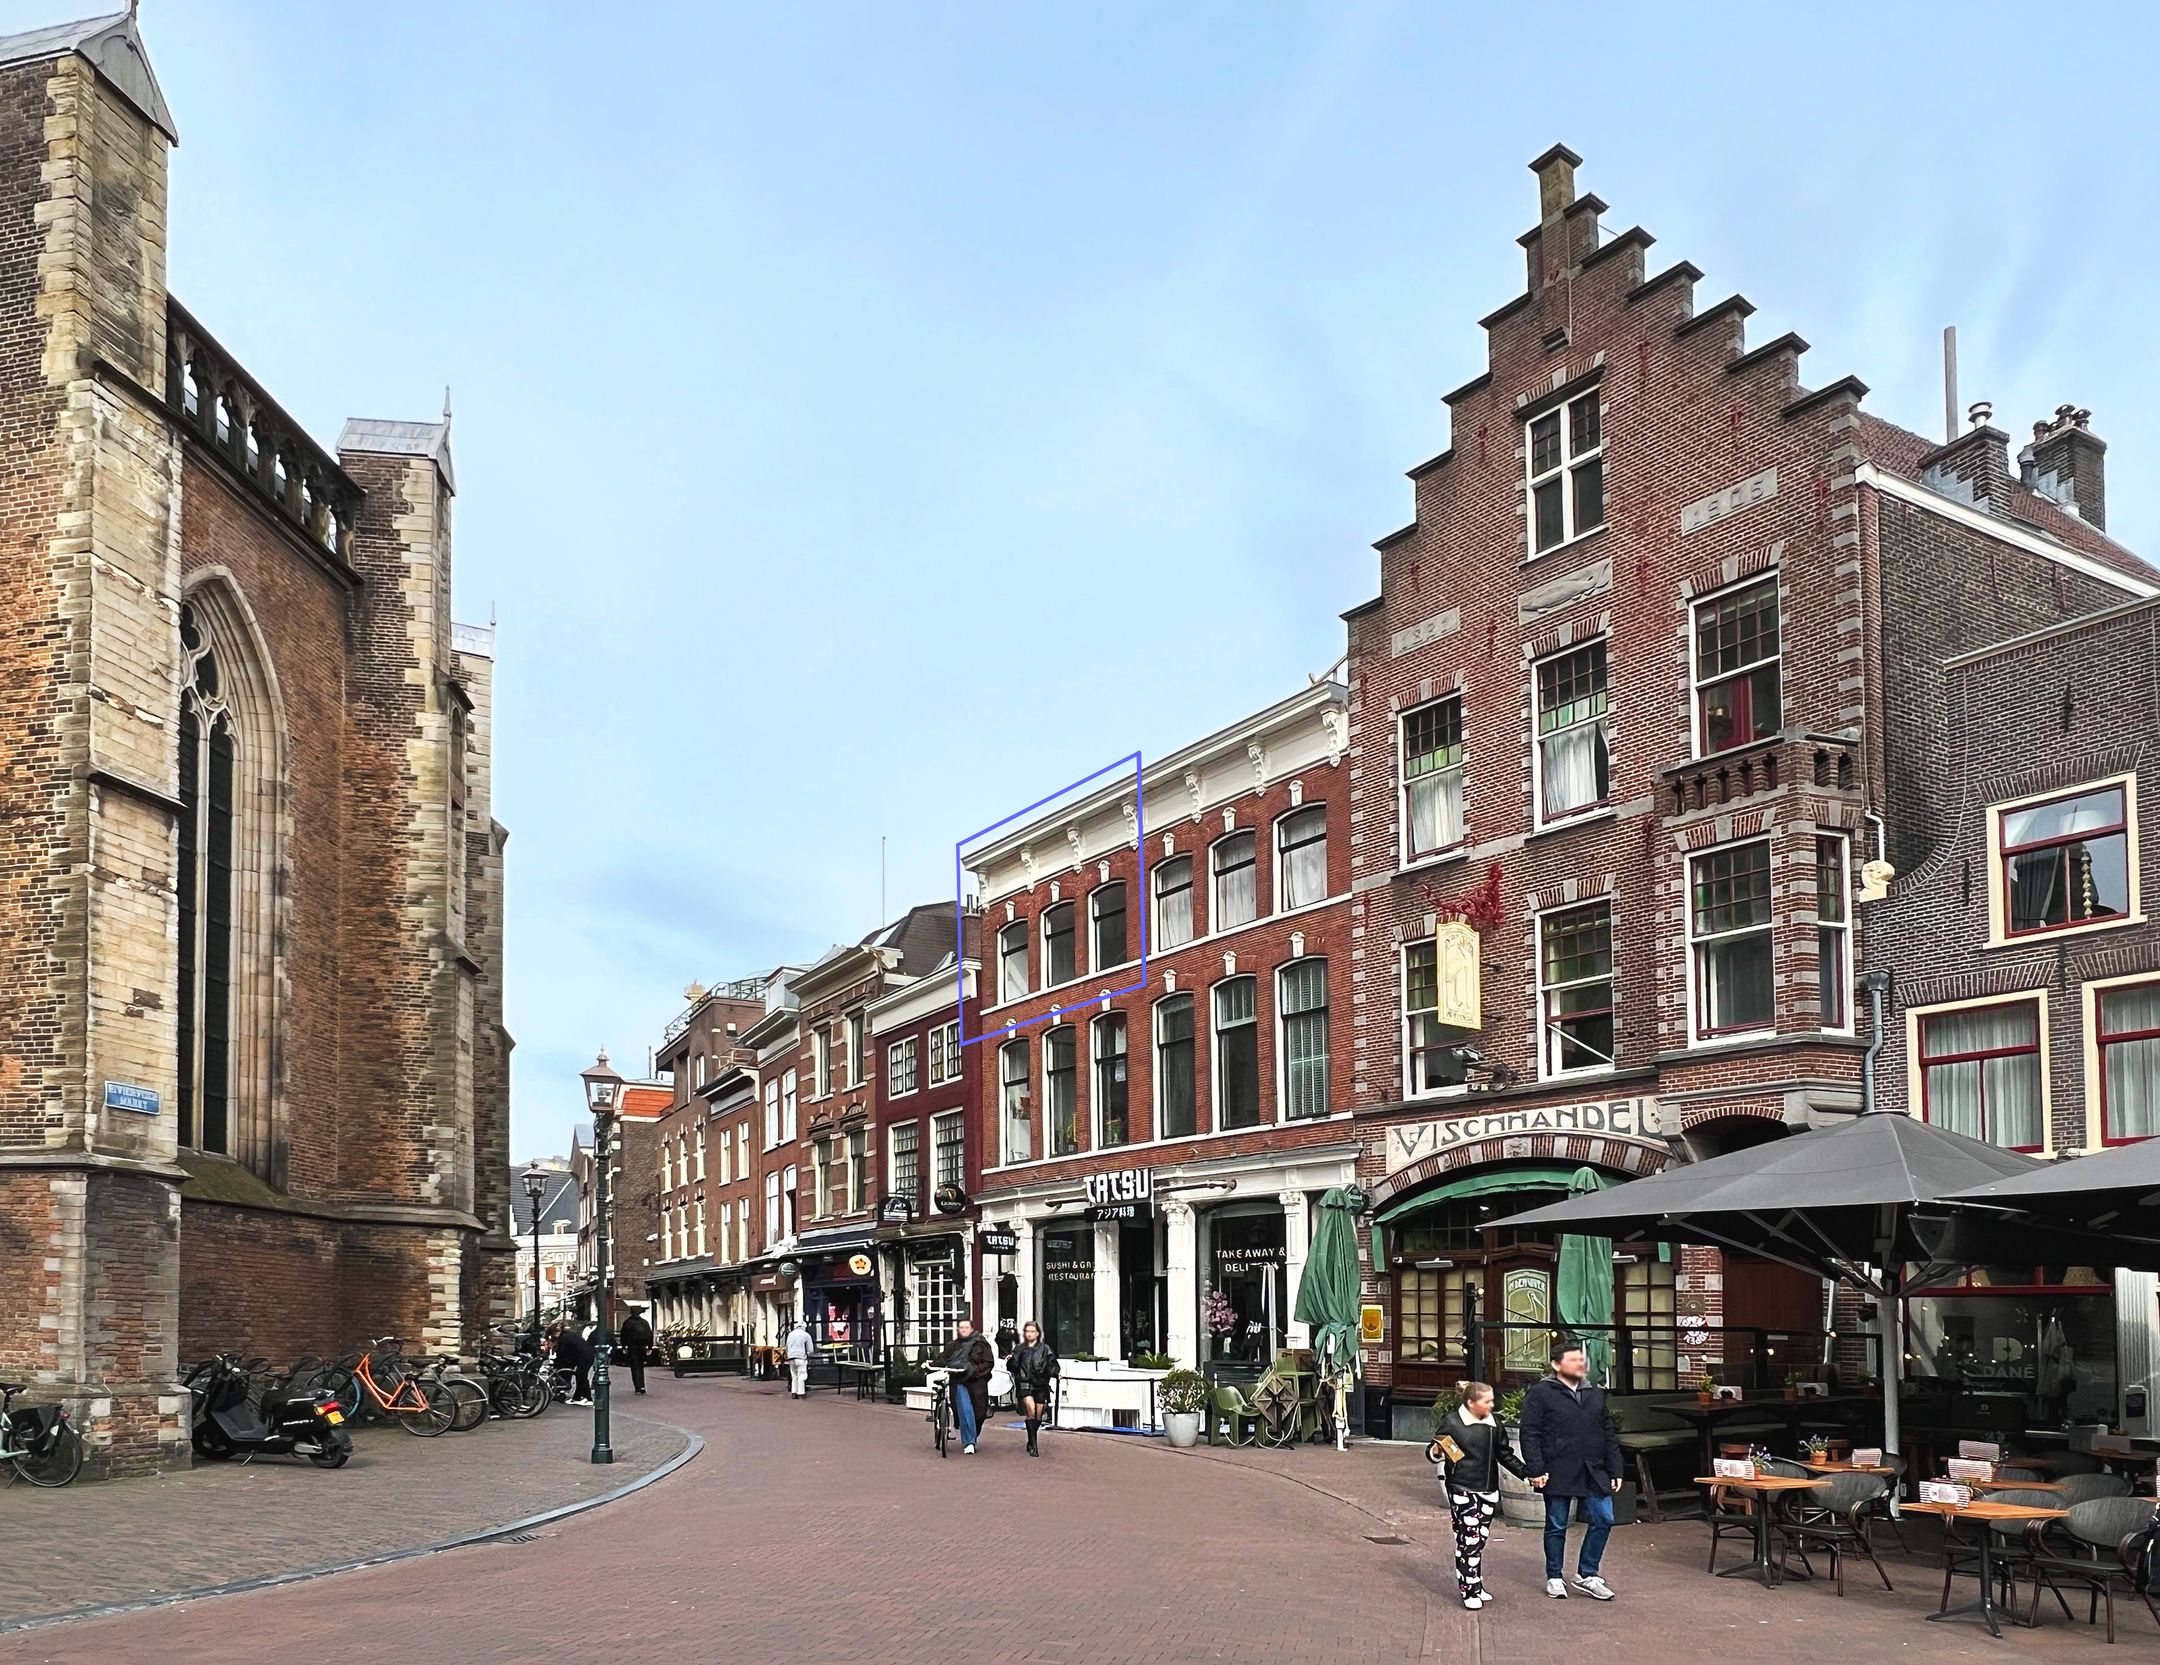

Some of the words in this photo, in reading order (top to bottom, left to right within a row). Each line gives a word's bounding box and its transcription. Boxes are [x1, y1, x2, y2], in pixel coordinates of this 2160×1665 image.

[1392, 1099, 1663, 1157] VISCHHANDEL
[1083, 1168, 1149, 1204] TATSU
[986, 1235, 1014, 1246] TATSU
[1216, 1249, 1242, 1259] TAKE
[1244, 1248, 1275, 1258] AWAY
[1278, 1246, 1287, 1257] &
[1046, 1261, 1071, 1270] SUSHI
[1072, 1260, 1079, 1269] &
[1079, 1260, 1096, 1270] GR
